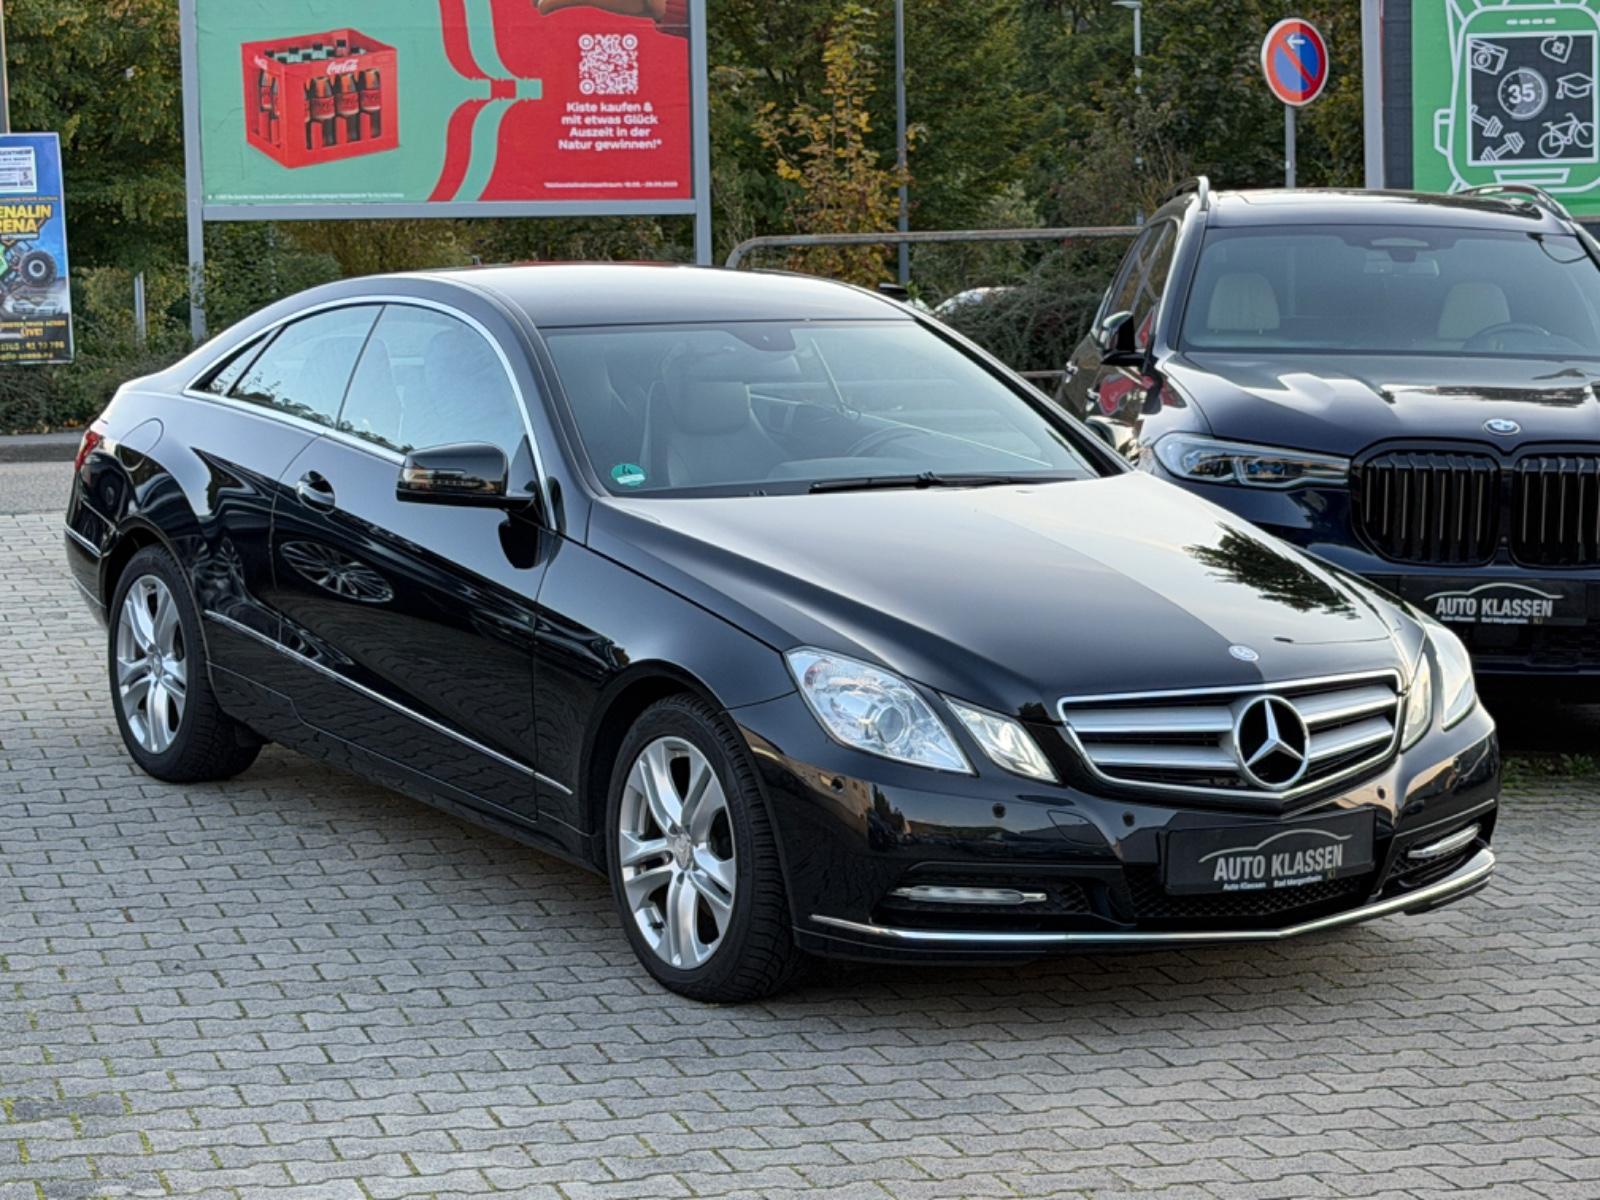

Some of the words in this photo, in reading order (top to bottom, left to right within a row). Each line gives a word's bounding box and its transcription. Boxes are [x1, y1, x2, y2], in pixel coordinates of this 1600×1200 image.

[1507, 83, 1536, 104] 35
[566, 102, 598, 112] Kiste
[600, 102, 641, 112] kaufen
[643, 102, 653, 112] &
[561, 115, 582, 125] mit
[584, 116, 621, 125] etwas
[623, 114, 658, 124] Glück
[569, 127, 614, 137] Auszeit
[616, 127, 628, 137] in
[629, 127, 651, 137] der
[558, 139, 593, 149] Natur
[1435, 597, 1477, 615] AUTO
[1481, 599, 1553, 617] KLASSEN
[1214, 855, 1266, 881] AUTO
[1271, 844, 1343, 877] KLASSEN
